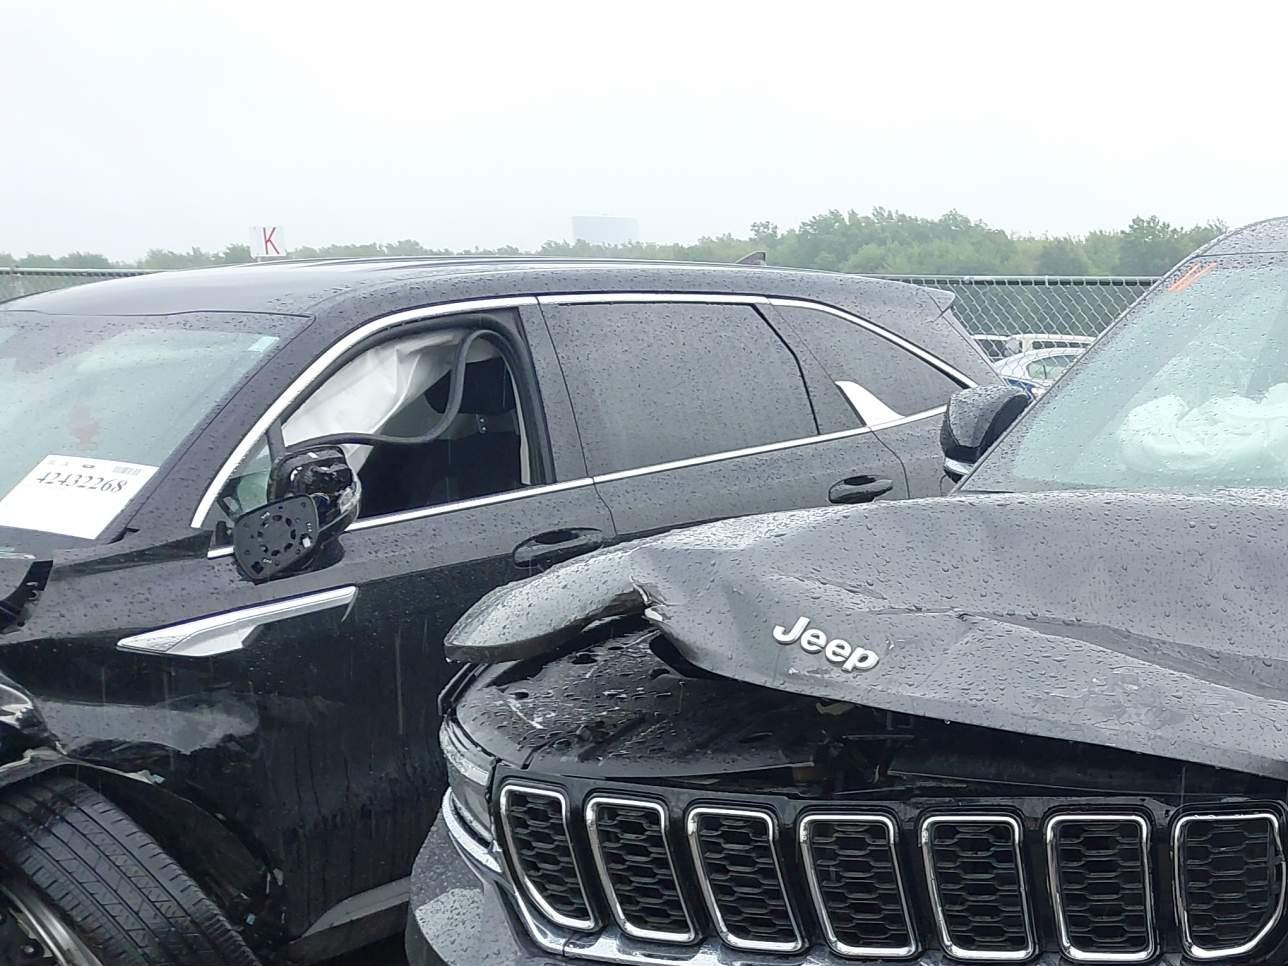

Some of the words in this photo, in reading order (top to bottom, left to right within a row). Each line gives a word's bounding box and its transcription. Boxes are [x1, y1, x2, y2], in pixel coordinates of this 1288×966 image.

[263, 226, 280, 255] K
[36, 471, 128, 493] 42432268
[772, 616, 880, 673] Jeep
